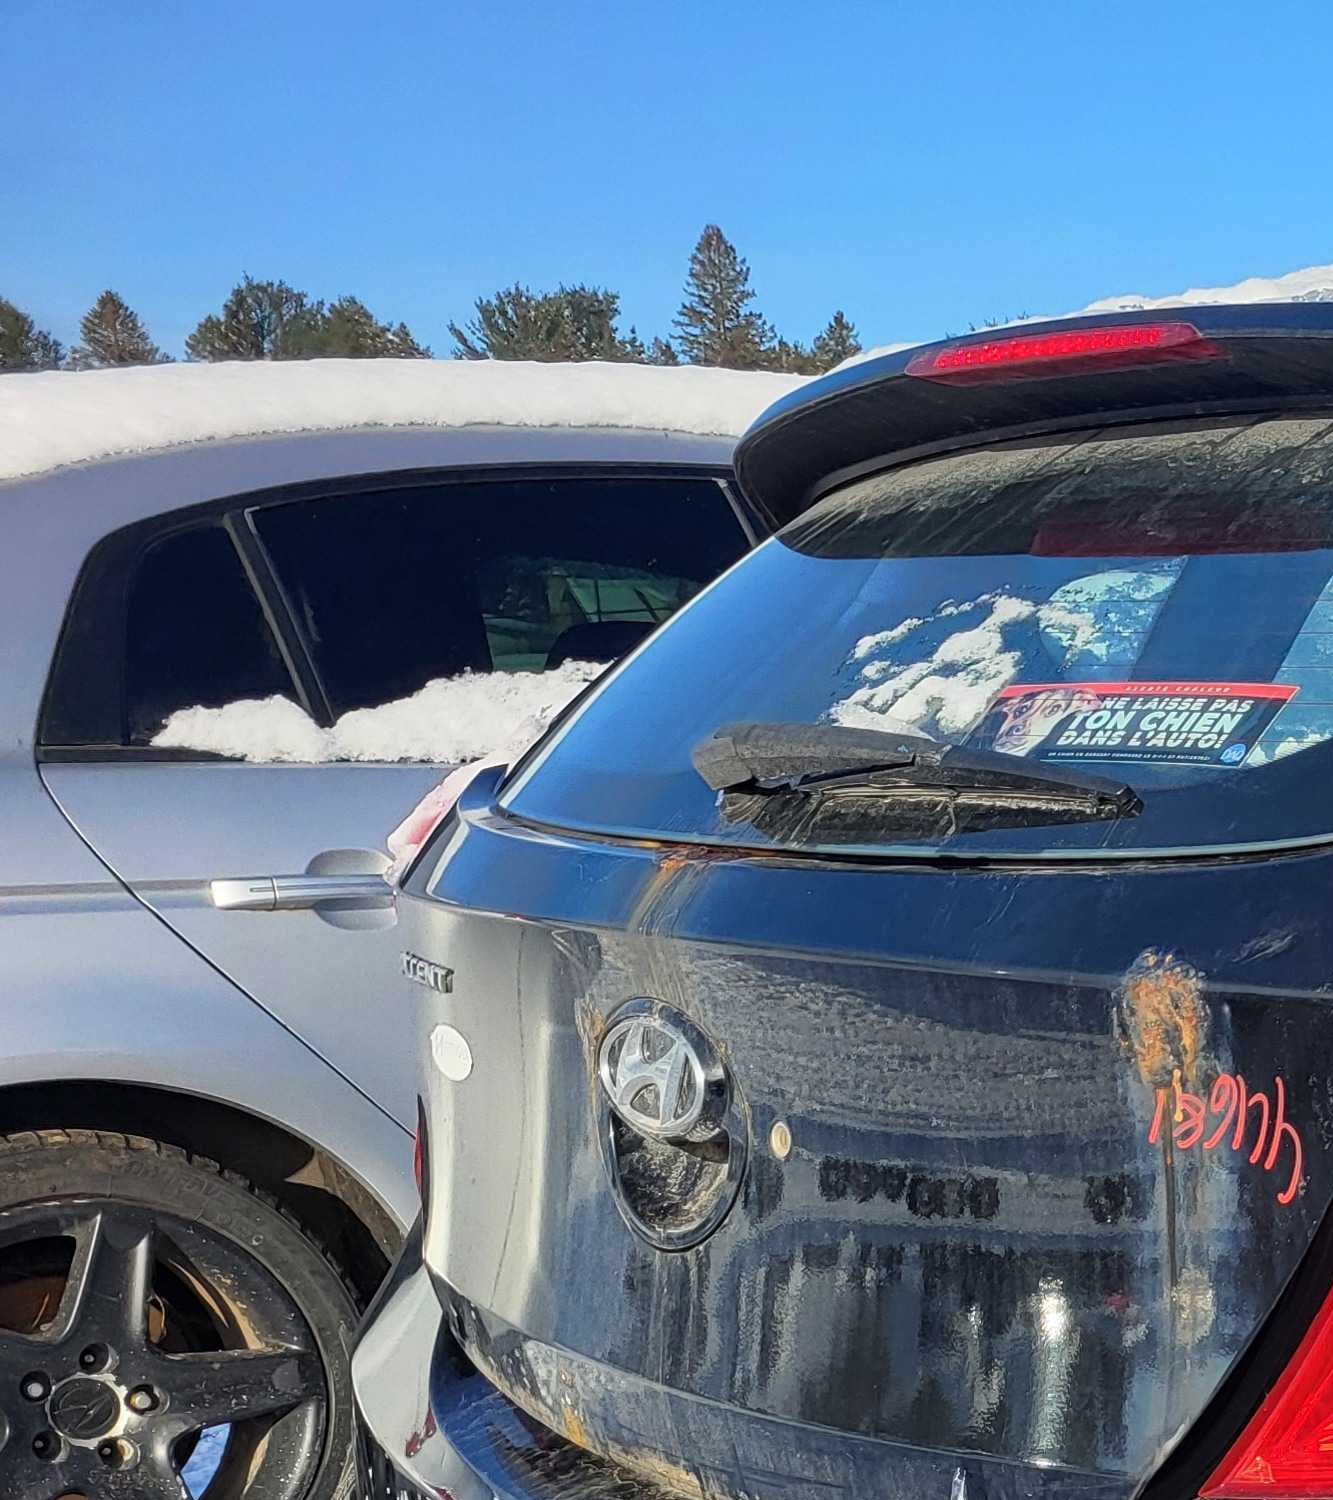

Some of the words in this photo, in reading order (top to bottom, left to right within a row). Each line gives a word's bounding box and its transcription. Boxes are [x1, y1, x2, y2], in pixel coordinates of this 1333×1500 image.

[1100, 697, 1131, 710] NE
[1132, 697, 1208, 711] LAISSE
[1209, 699, 1255, 713] PAS
[1067, 710, 1137, 730] TON
[1139, 711, 1243, 733] CHIEN
[1056, 730, 1127, 746] DANS
[1127, 731, 1230, 749] L'AUTO!
